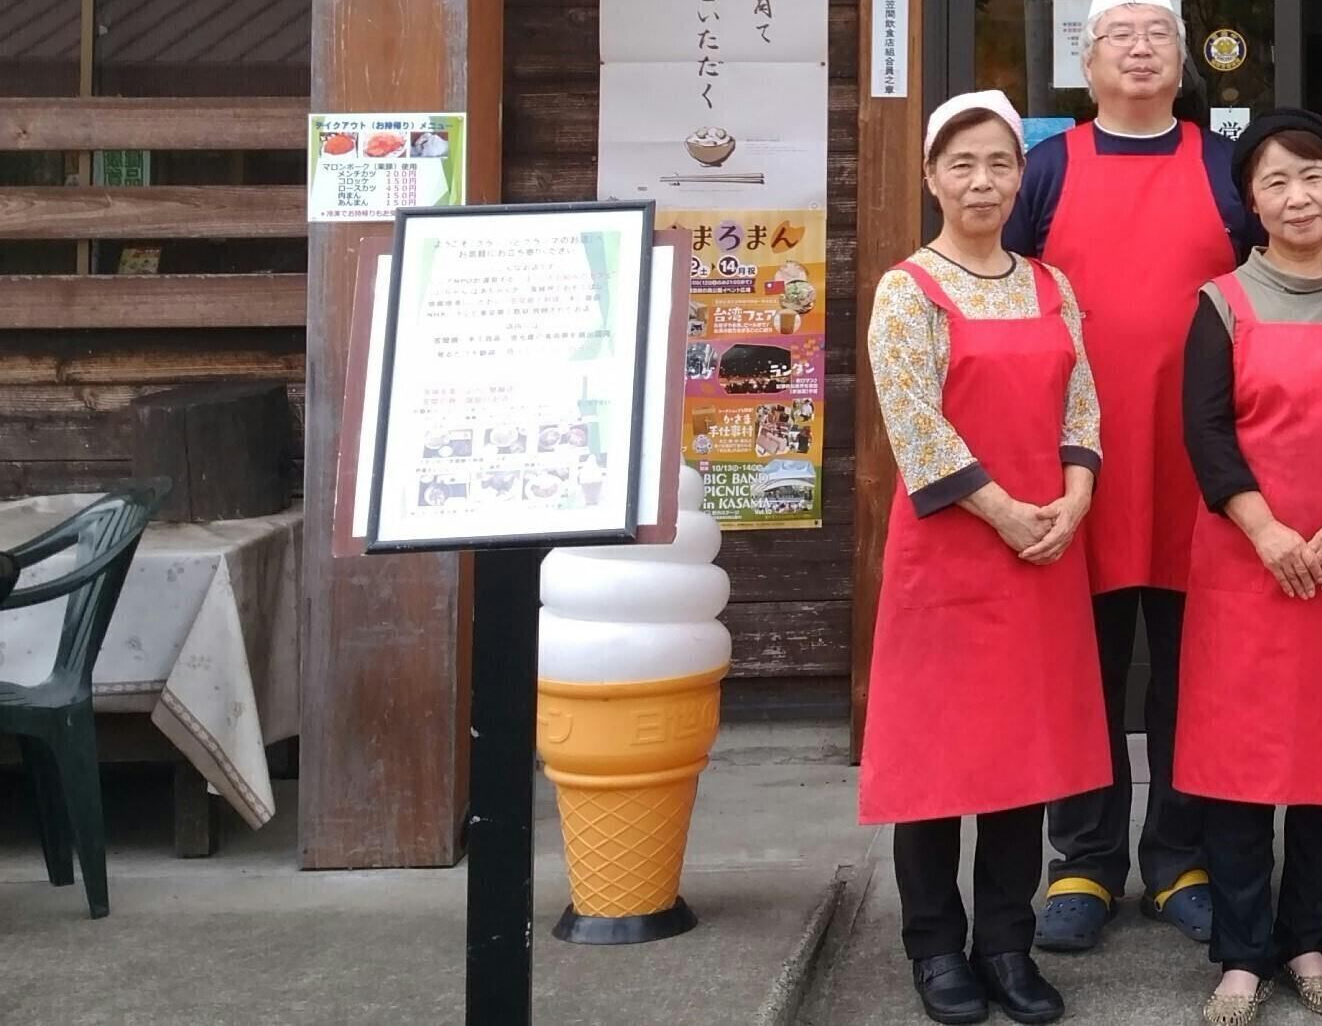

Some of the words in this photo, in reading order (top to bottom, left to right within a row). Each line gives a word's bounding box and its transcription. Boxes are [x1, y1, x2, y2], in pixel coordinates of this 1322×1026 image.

[671, 224, 799, 251] まろまん
[713, 306, 777, 322] 台湾フェア
[770, 363, 815, 378] ランタン
[708, 425, 753, 438] 手仕事村
[703, 473, 727, 485] BIG
[732, 472, 769, 485] BAND
[703, 485, 750, 497] PICNIC
[703, 499, 715, 509] in
[719, 497, 771, 509] KASAMA
